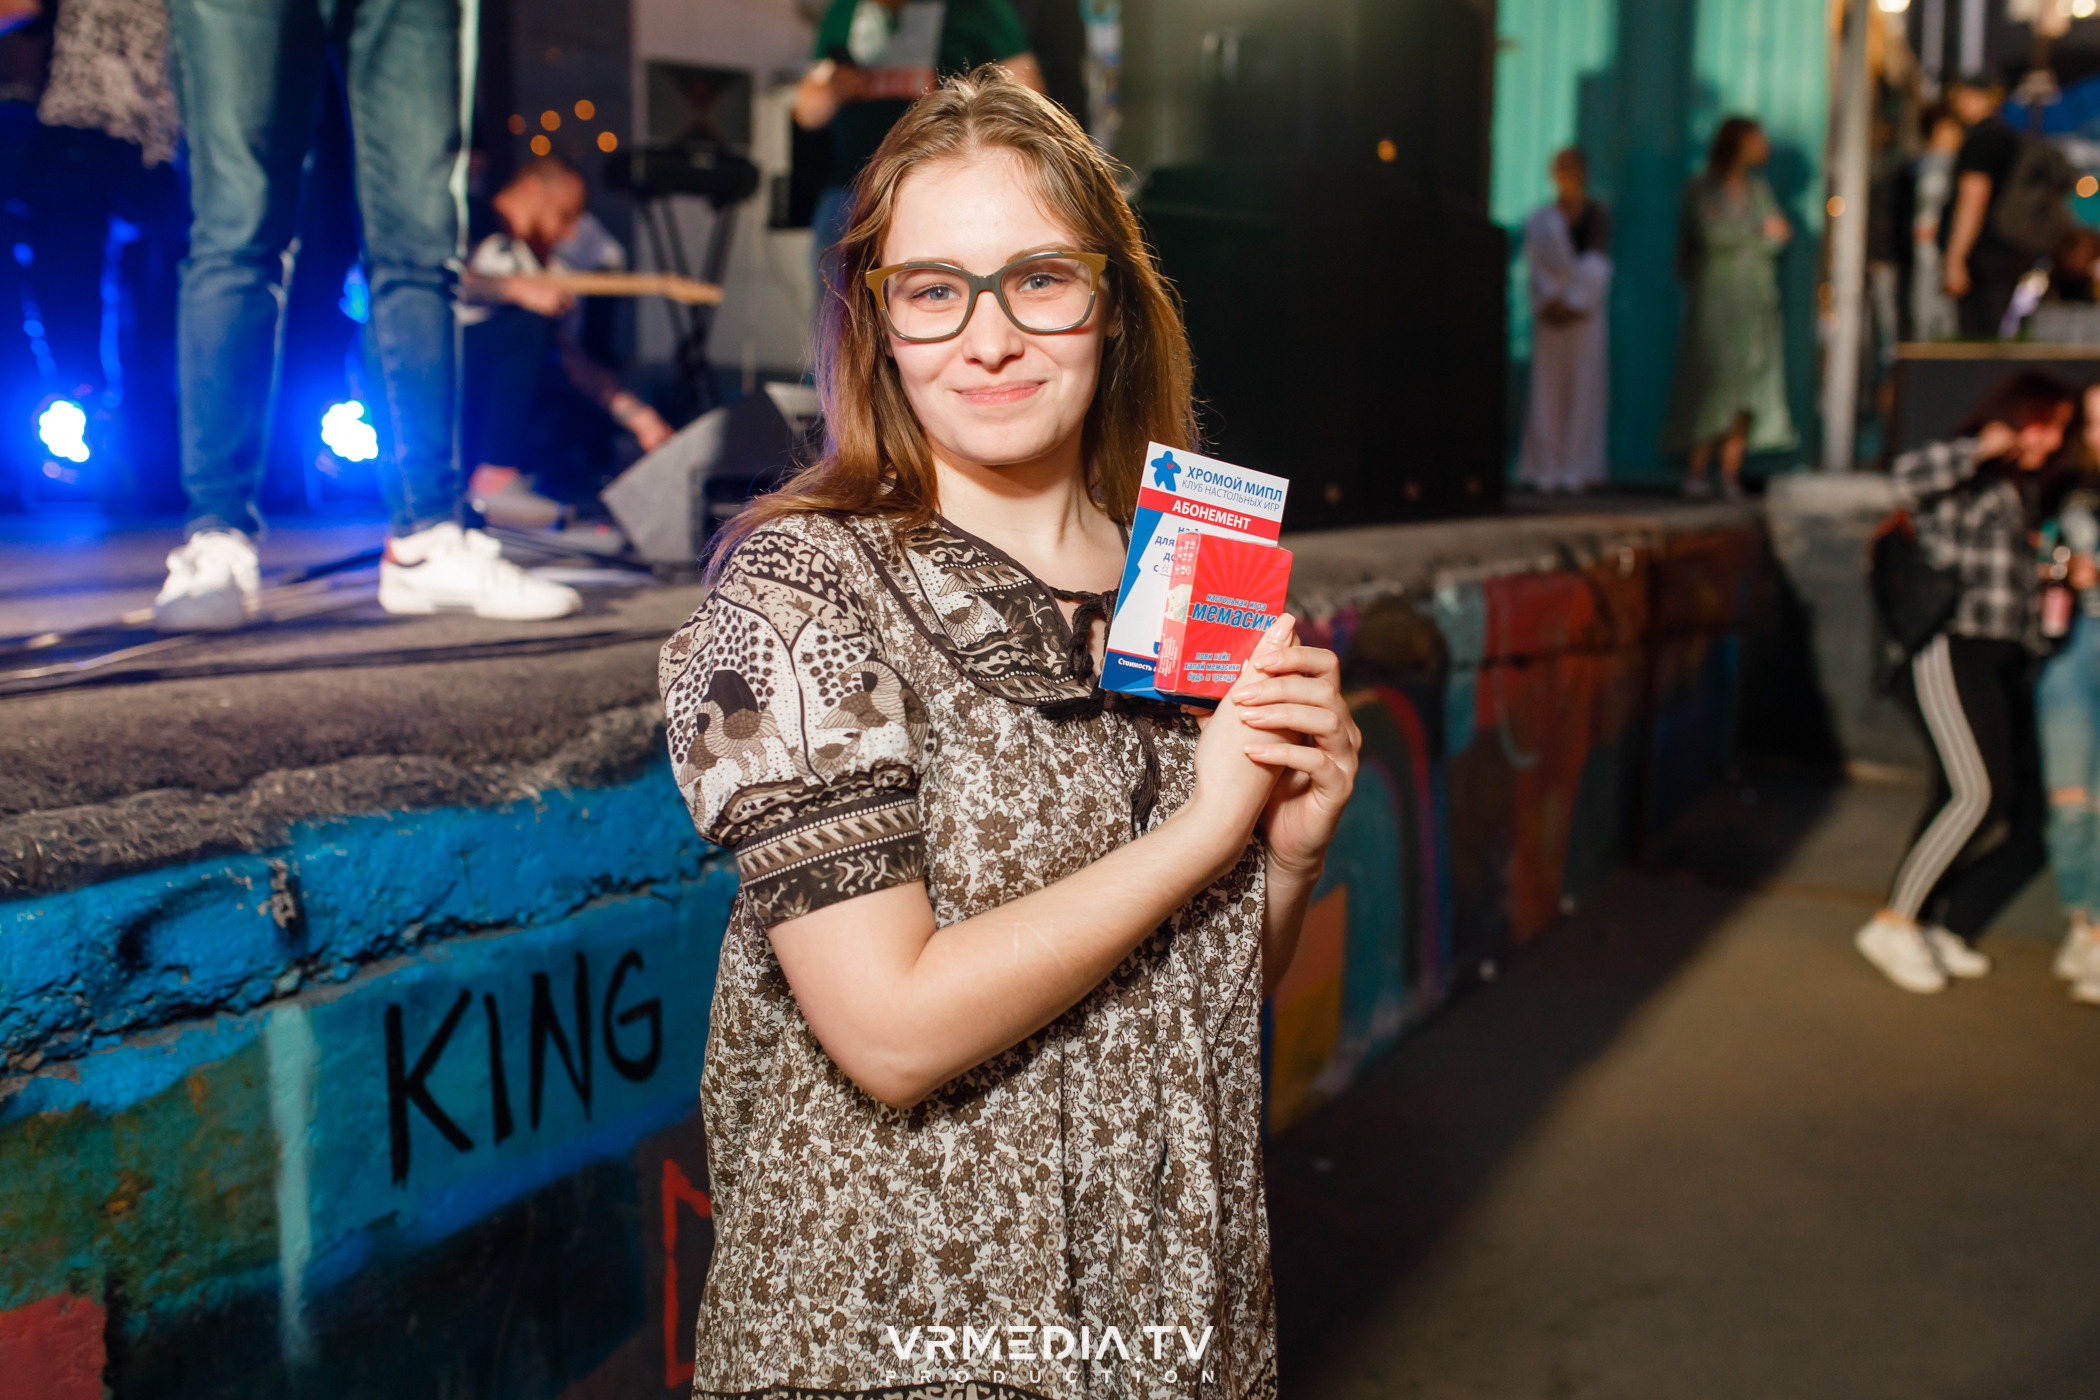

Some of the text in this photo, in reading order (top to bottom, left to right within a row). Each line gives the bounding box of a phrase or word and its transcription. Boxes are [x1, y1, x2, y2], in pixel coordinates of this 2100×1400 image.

[1182, 479, 1280, 512] КЛУБ НАСТОЛЬНЫХ ИГР
[1187, 466, 1283, 502] ХРОМОЙ МИПЛ
[1172, 499, 1251, 530] АБОНЕМЕНТ
[1155, 535, 1175, 547] для
[1206, 594, 1267, 611] настольная игра
[1118, 657, 1152, 671] Стоимость
[385, 949, 662, 1189] KING
